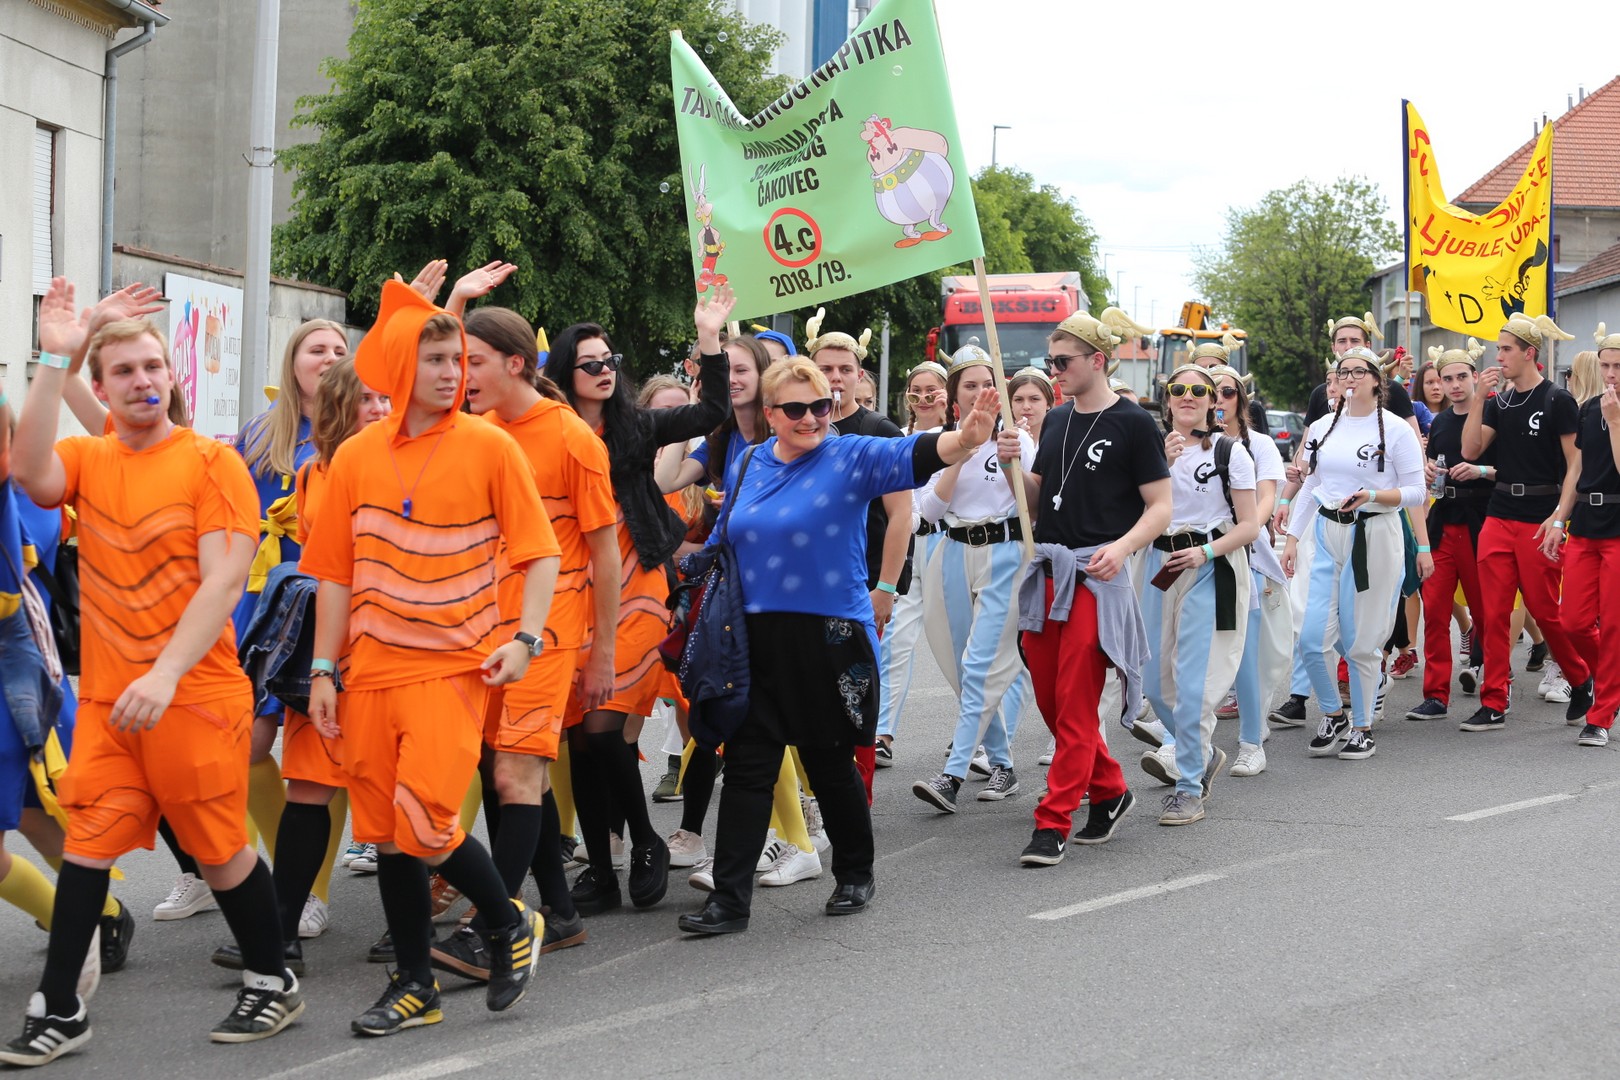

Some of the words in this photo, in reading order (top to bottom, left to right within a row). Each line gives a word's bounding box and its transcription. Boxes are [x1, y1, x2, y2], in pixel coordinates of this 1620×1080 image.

[810, 18, 912, 88] NAPITKA
[758, 168, 820, 207] ČAKOVEC
[769, 260, 852, 298] 2018./19.
[963, 296, 1056, 314] BKŠIĆ
